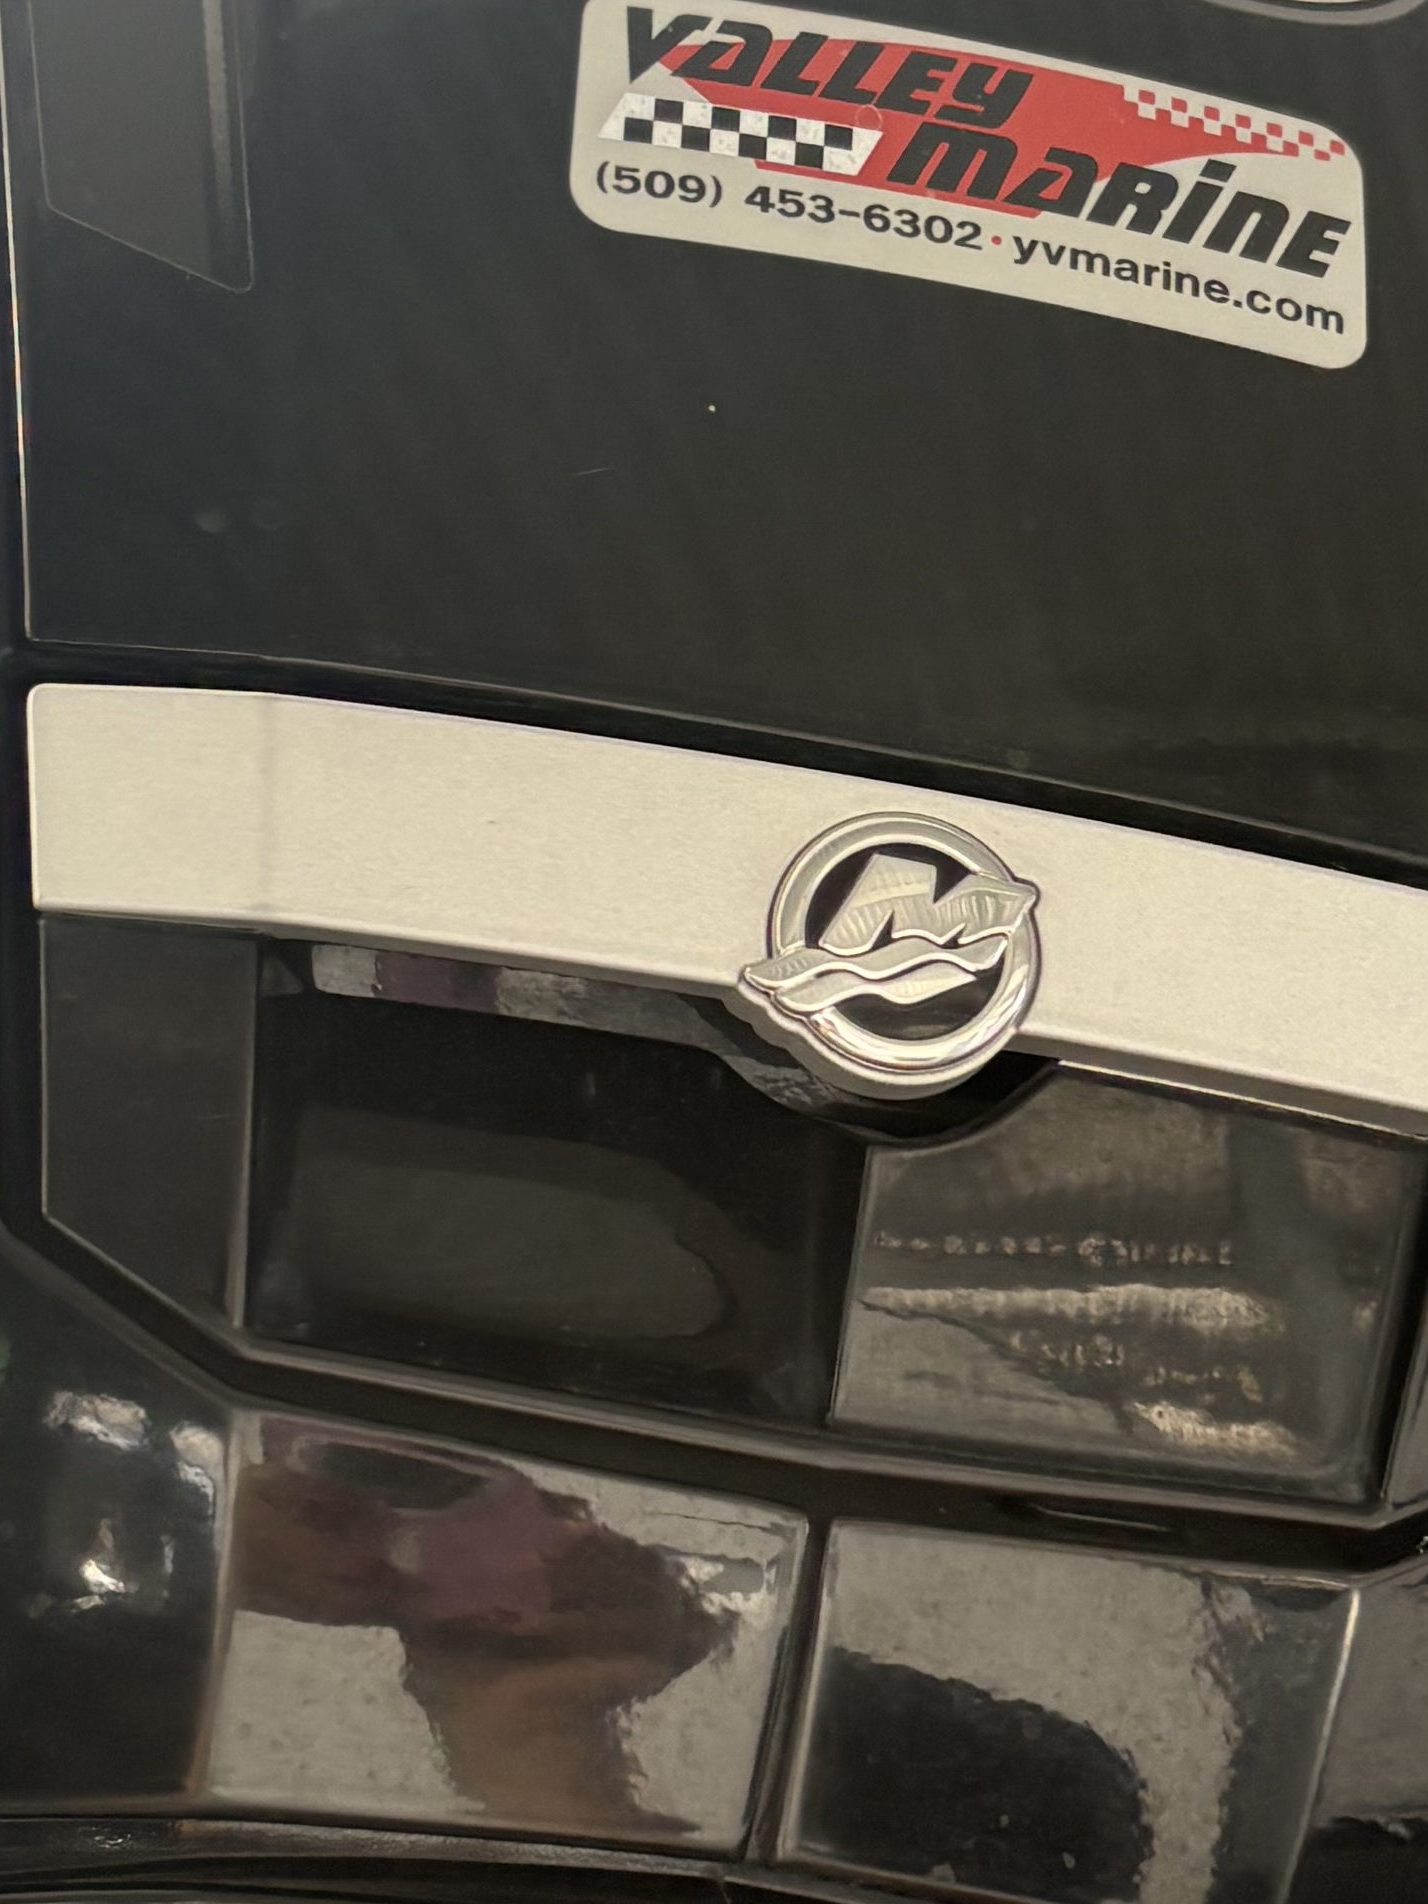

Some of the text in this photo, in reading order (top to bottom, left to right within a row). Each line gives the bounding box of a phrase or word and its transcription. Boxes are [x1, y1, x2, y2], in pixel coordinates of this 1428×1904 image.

[595, 159, 1345, 335] (509) 453-6302 yvmarine.com
